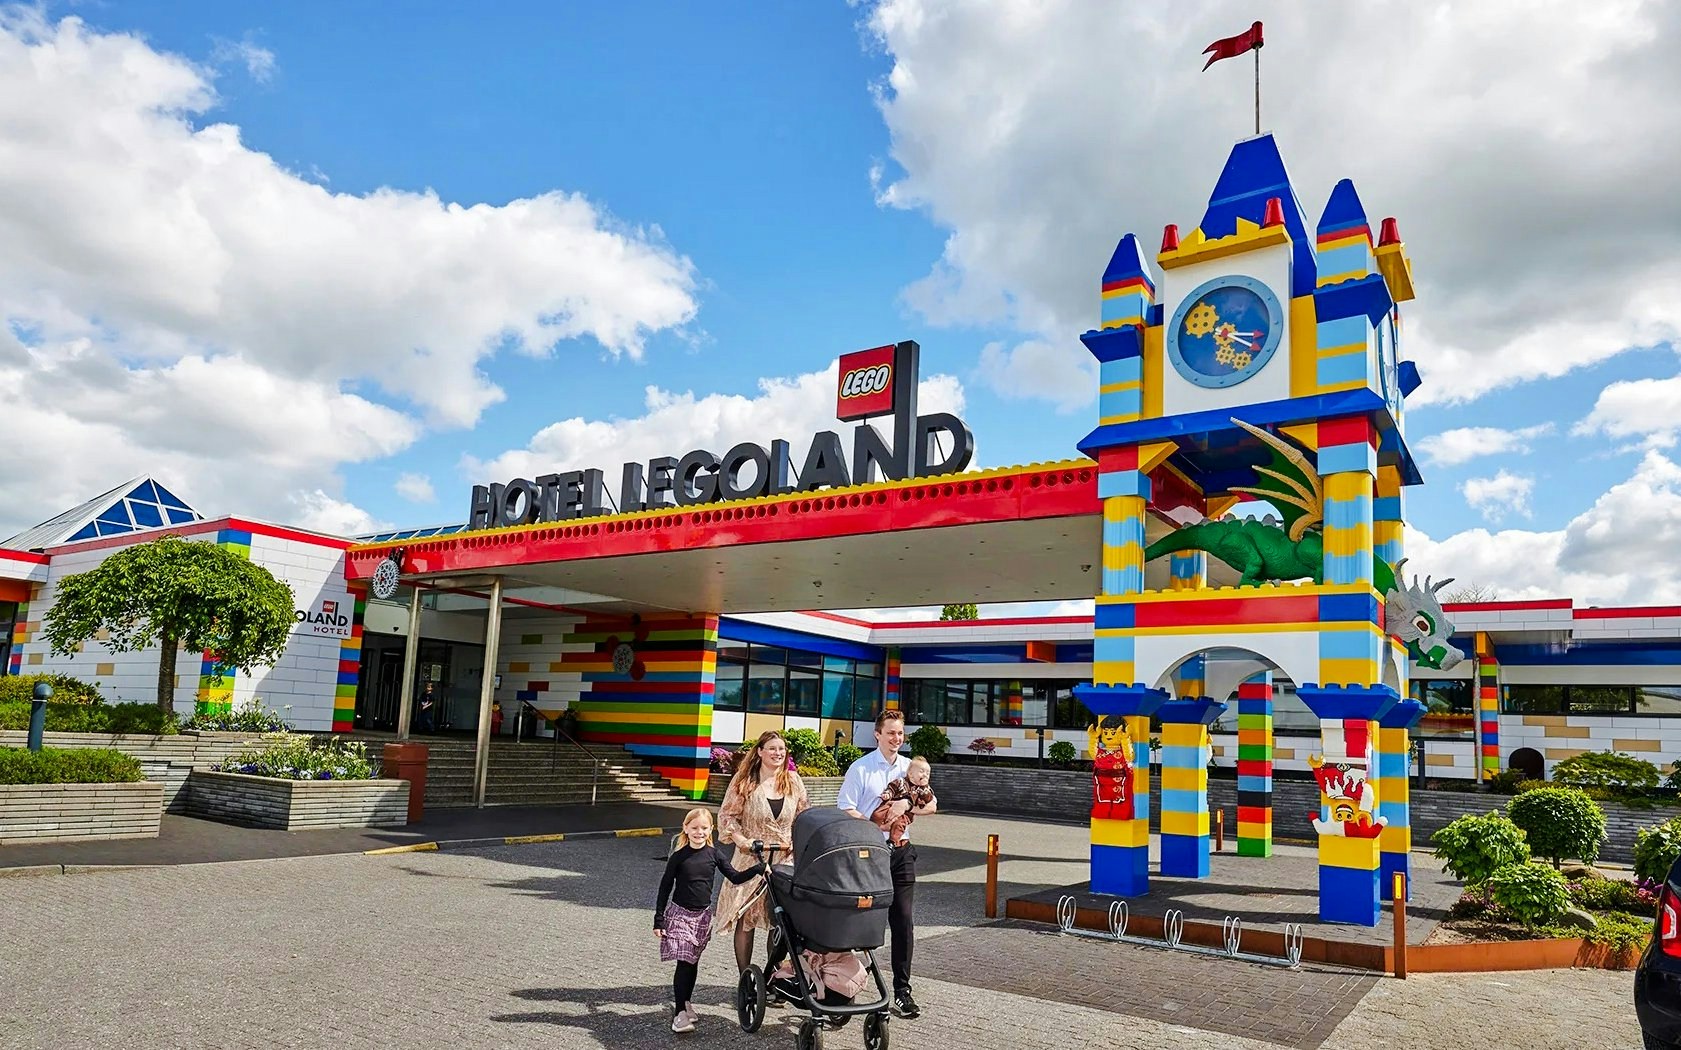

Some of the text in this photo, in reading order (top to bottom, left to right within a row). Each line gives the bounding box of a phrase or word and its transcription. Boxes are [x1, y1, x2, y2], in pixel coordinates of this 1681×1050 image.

[840, 364, 891, 399] LEGO
[469, 340, 974, 530] HOTEL LEGOLAND
[295, 602, 348, 626] OLAND
[313, 626, 348, 635] HOTEL
